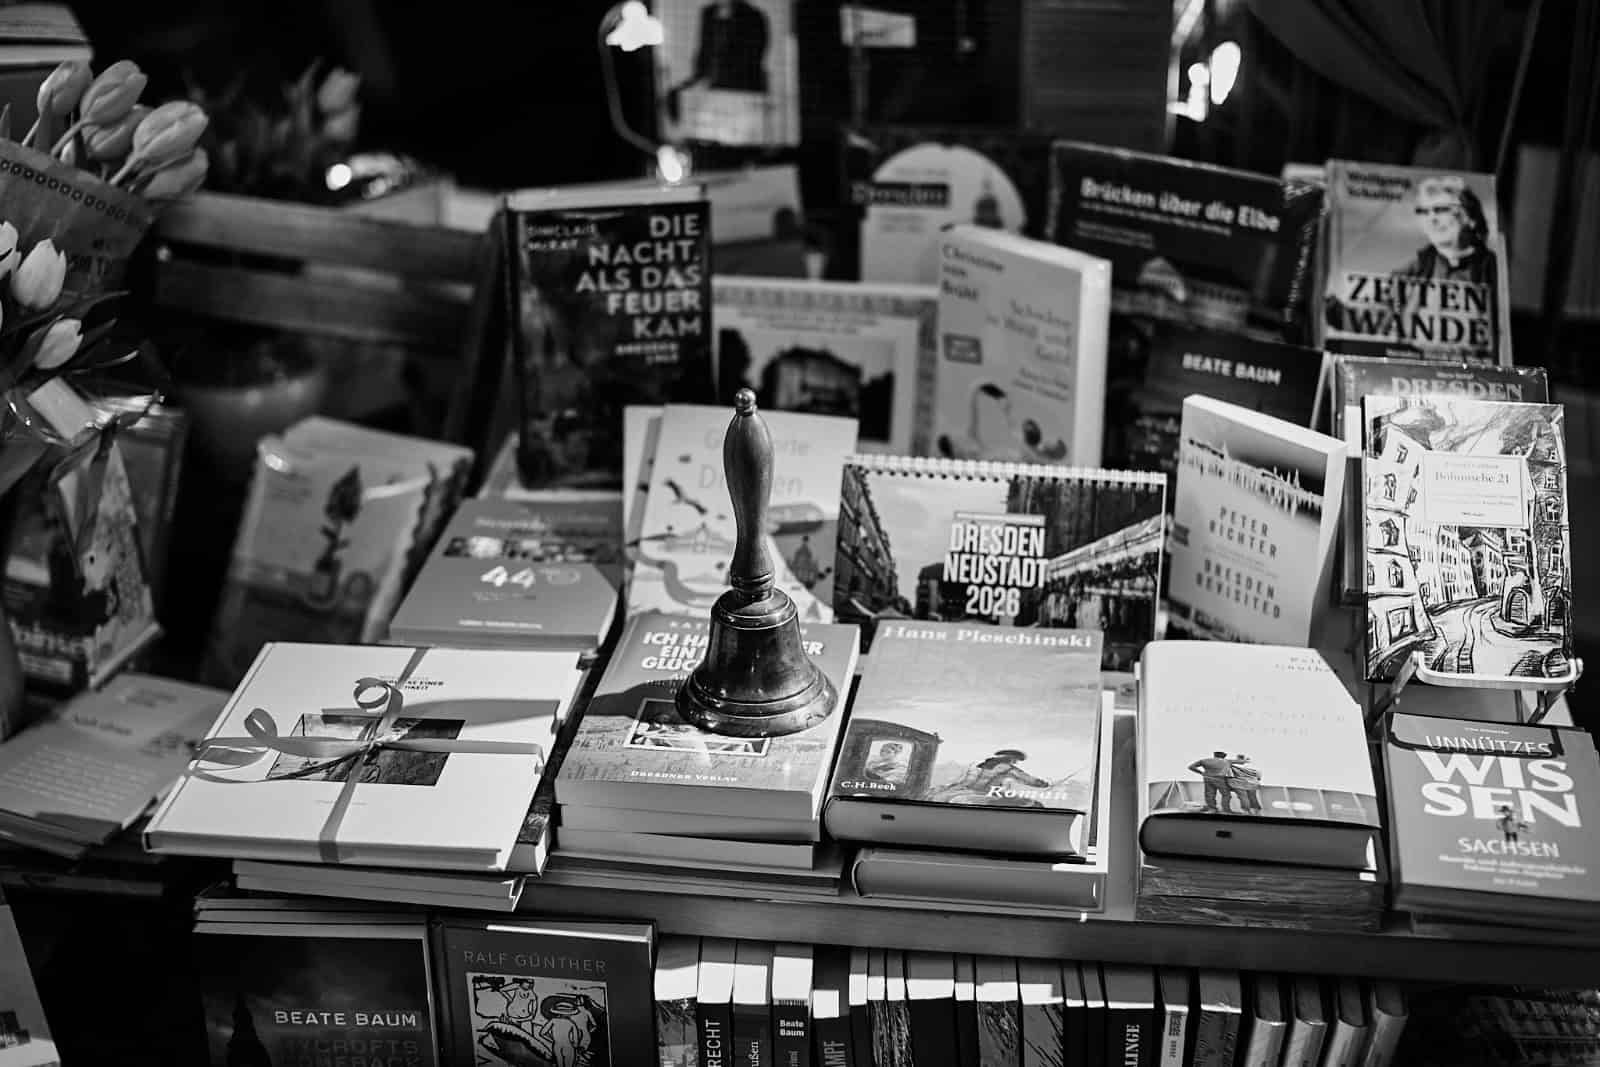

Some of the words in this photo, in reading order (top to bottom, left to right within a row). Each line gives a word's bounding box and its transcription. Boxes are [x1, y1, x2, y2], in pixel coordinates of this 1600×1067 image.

[1080, 176, 1156, 208] Brücken
[1159, 191, 1202, 217] über
[1204, 200, 1235, 224] die
[1238, 205, 1280, 232] Elbe
[650, 214, 700, 238] DIE
[576, 267, 631, 293] ALS
[641, 265, 701, 288] DAS
[607, 289, 701, 316] FEUER
[1347, 274, 1487, 313] ZEITEN
[633, 316, 701, 339] KAM
[1182, 352, 1232, 376] BEATE
[1235, 361, 1281, 387] BAUM
[1391, 376, 1522, 401] DRESDEN
[1219, 506, 1269, 537] PETER
[951, 523, 1045, 557] DRESDEN
[1209, 519, 1278, 560] RICHTER
[943, 552, 1049, 588] NEUSTADT
[1204, 558, 1275, 600] DRESDEN
[965, 585, 1021, 618] 2026
[1196, 572, 1281, 619] REVISITED
[643, 631, 679, 645] ICH
[882, 625, 947, 641] Hans
[956, 627, 1092, 649] Pleschinski
[660, 645, 697, 659] EIN
[1424, 735, 1552, 756] UNNÜTZES
[1415, 750, 1575, 793] WIS
[840, 781, 897, 792] C.H.Beck
[986, 784, 1069, 802] Roman
[1421, 781, 1582, 829] SEN
[1457, 837, 1561, 858] SACHSEN
[463, 950, 508, 967] RALF
[274, 1010, 347, 1025] BEATE
[355, 1012, 417, 1027] BAUM
[779, 1019, 805, 1029] Beate
[779, 1028, 805, 1038] Baum
